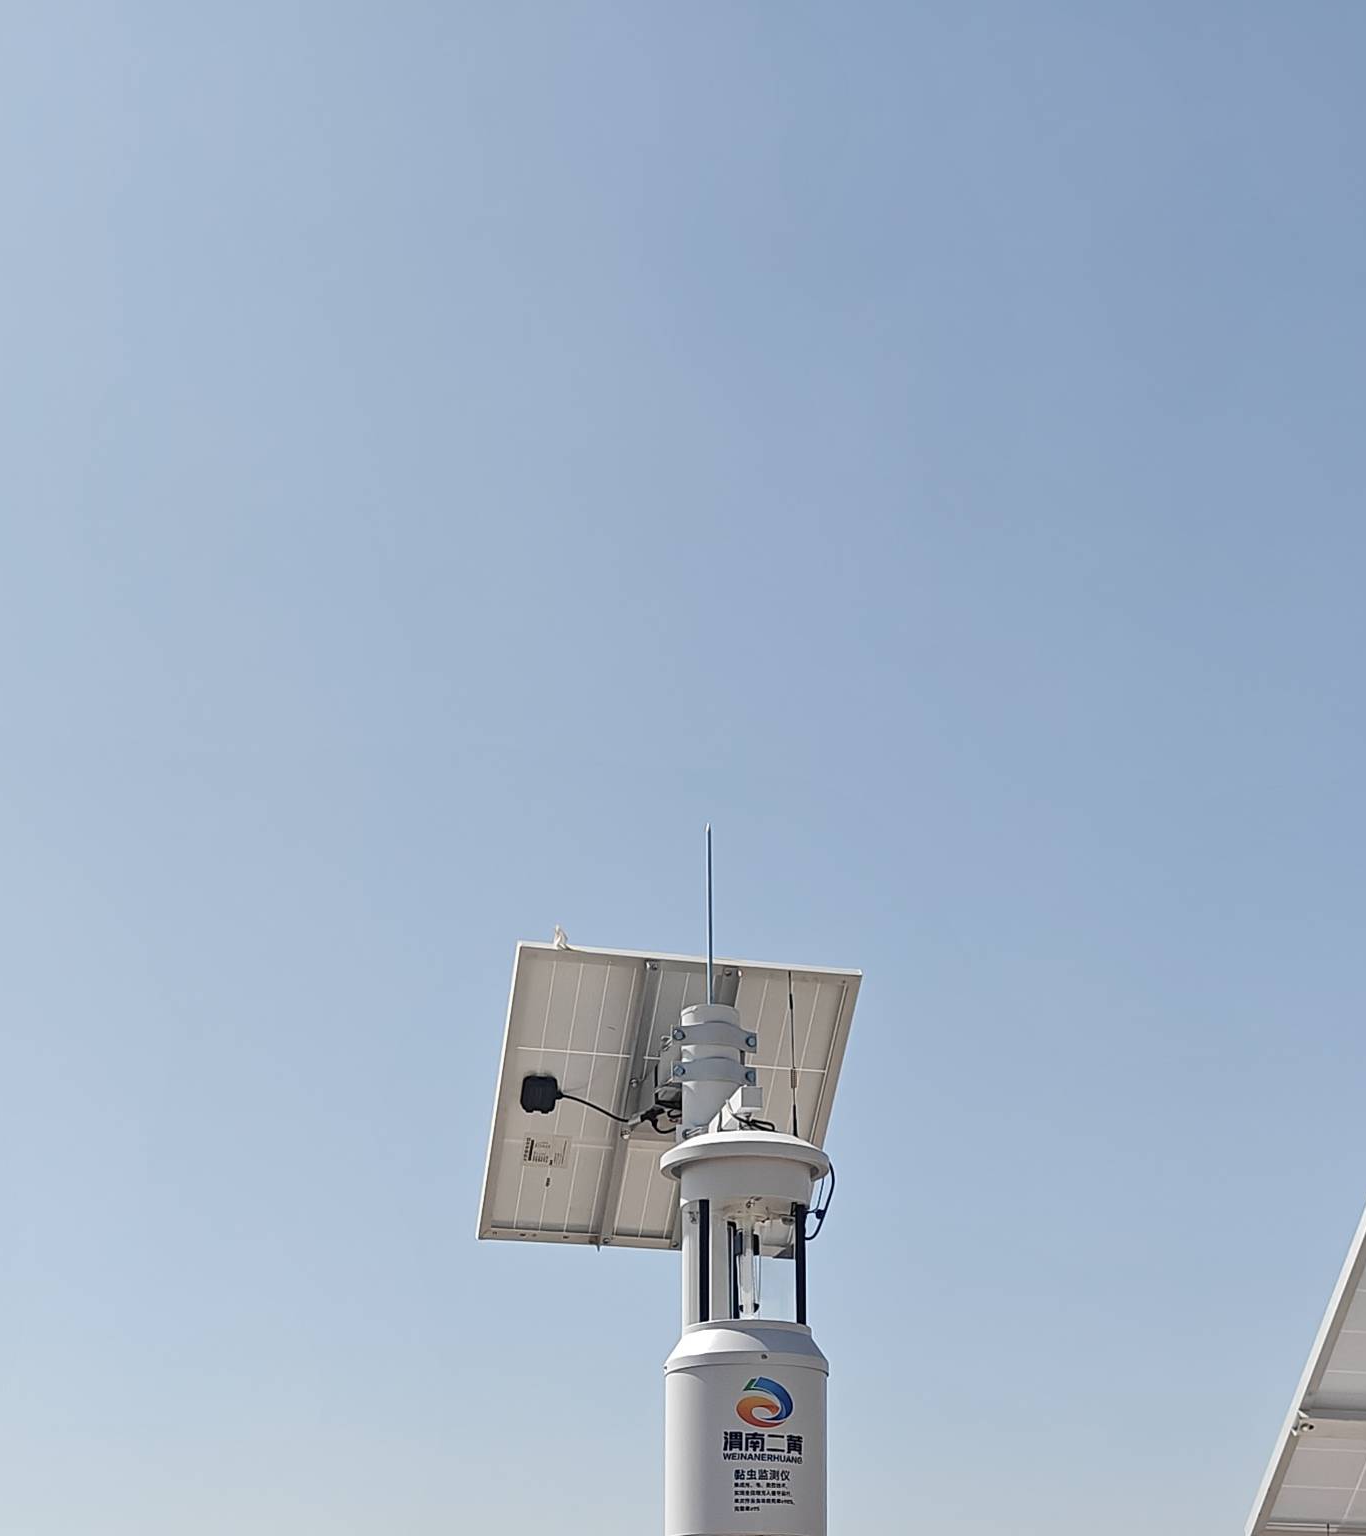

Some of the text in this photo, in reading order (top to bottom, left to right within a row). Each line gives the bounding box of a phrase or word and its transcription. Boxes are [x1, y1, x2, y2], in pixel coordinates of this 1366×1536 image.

[723, 1431, 804, 1455] 渭南二黄
[723, 1453, 803, 1464] WEINANERHUANG
